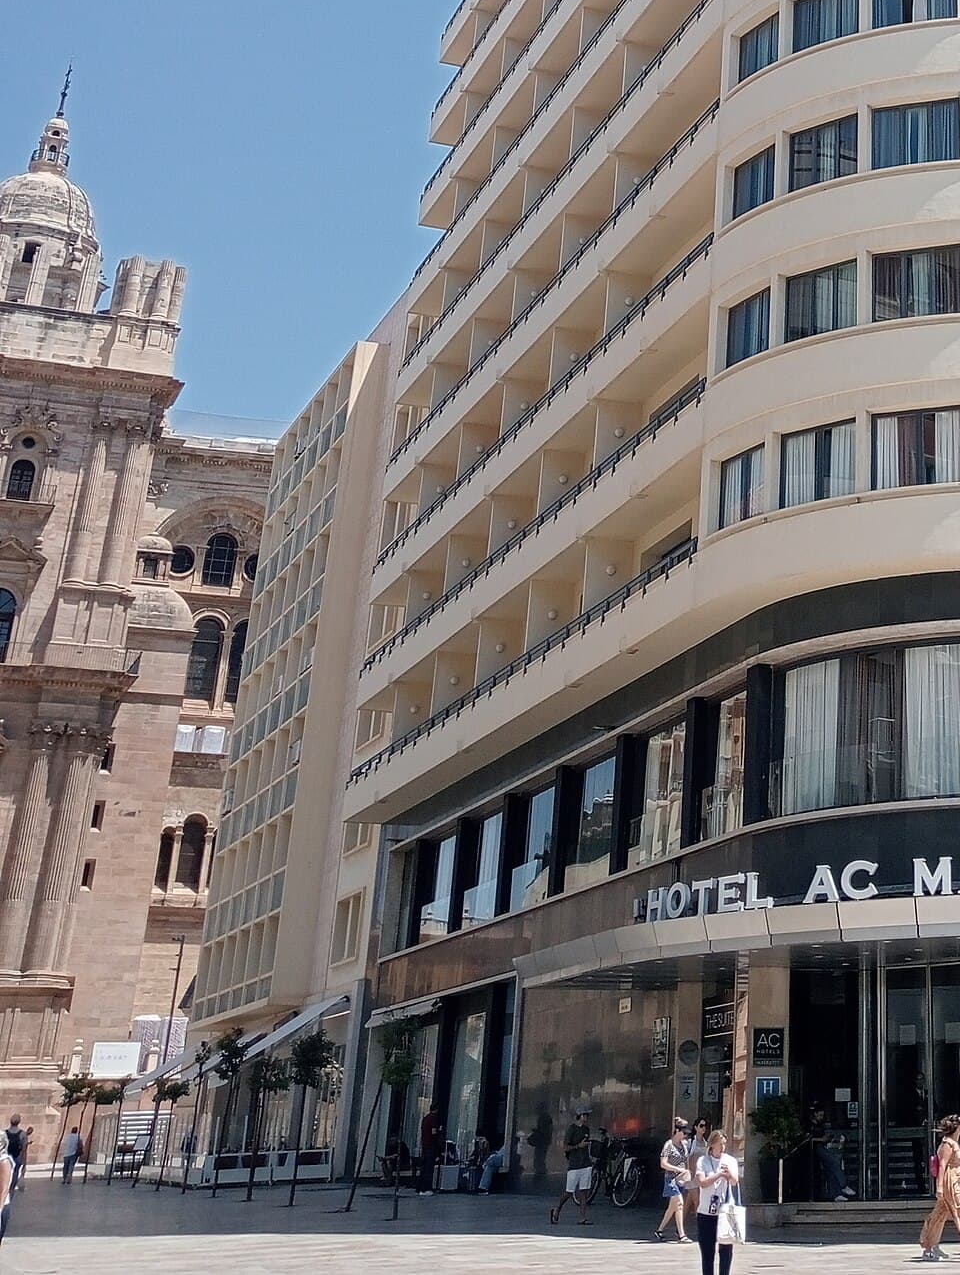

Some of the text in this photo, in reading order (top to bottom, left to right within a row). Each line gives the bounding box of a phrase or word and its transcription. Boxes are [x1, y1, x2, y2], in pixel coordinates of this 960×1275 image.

[646, 871, 774, 923] HOTEL
[803, 860, 879, 904] AC
[757, 1033, 780, 1048] AC
